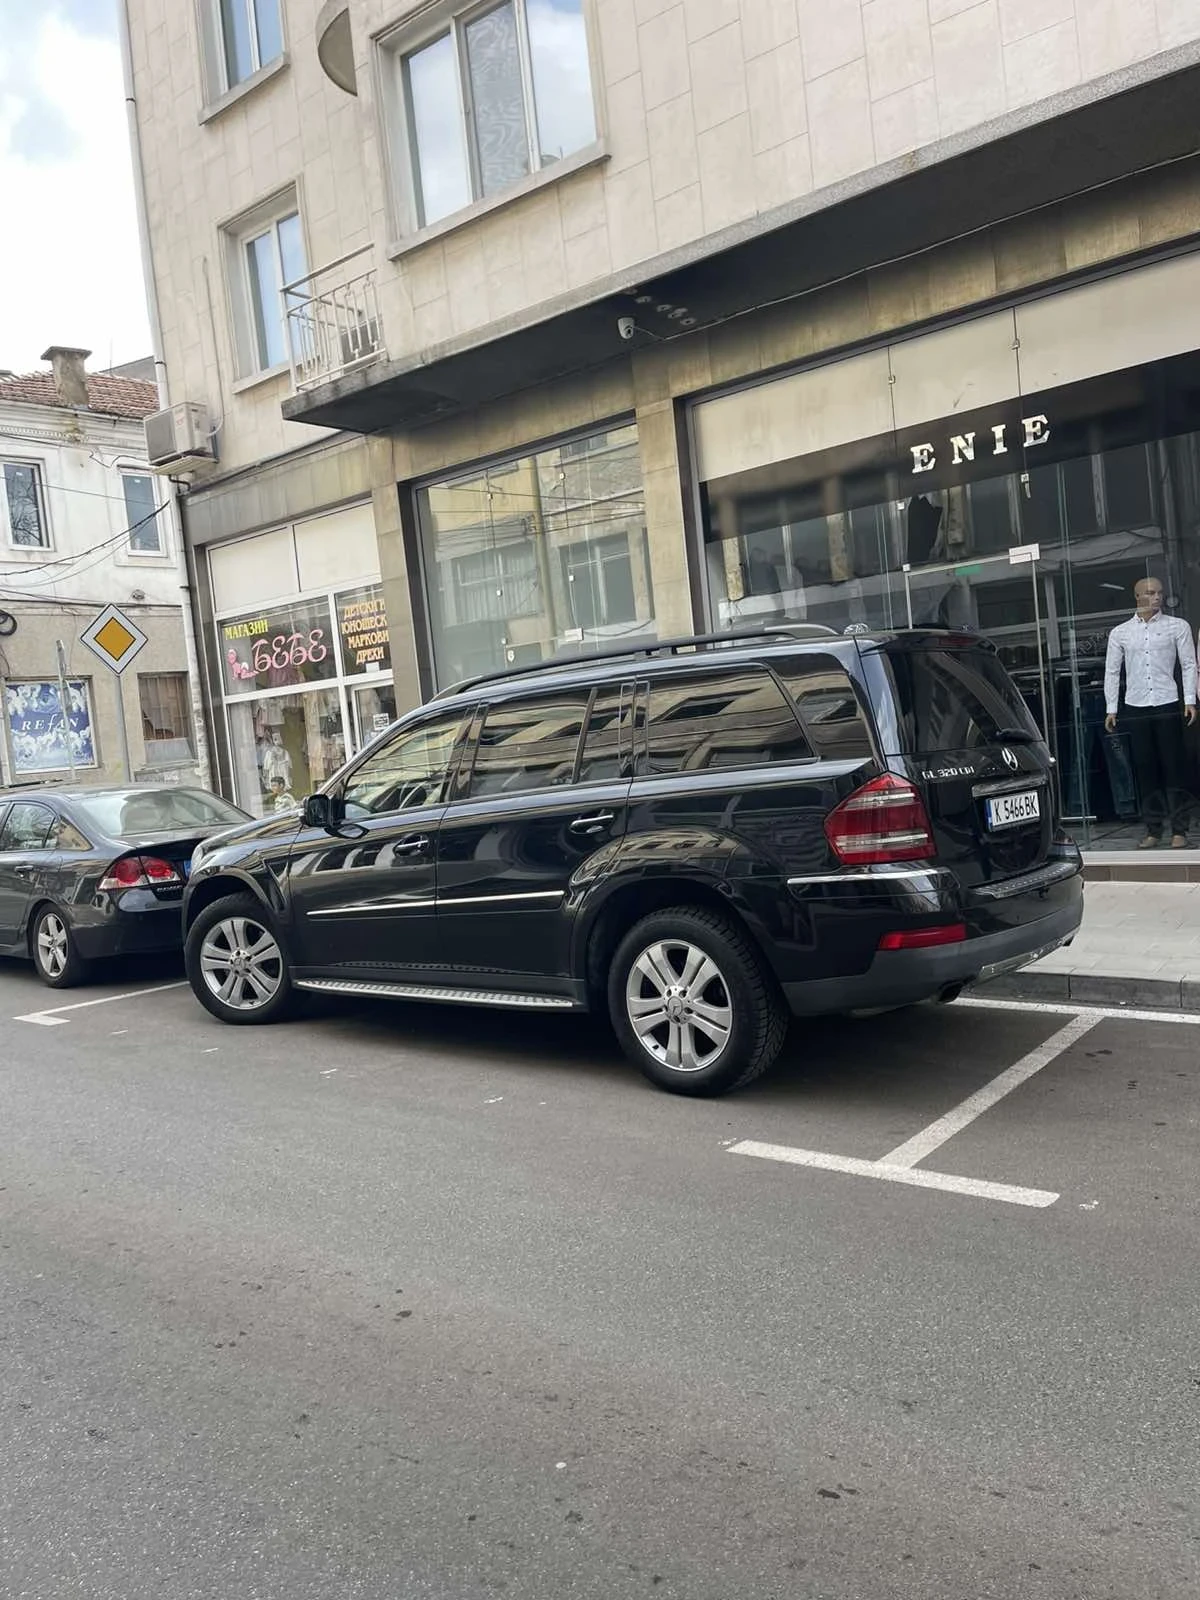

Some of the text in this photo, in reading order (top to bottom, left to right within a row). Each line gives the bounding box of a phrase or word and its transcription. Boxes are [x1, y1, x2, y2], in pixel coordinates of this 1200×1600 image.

[910, 414, 1051, 473] ENIE
[225, 619, 269, 640] МАГАЗИН
[347, 629, 390, 649] МАРКОВИ
[251, 629, 327, 672] БЕБЕ
[356, 646, 385, 665] ДРЕХИ
[921, 765, 975, 780] GL 320 CDI
